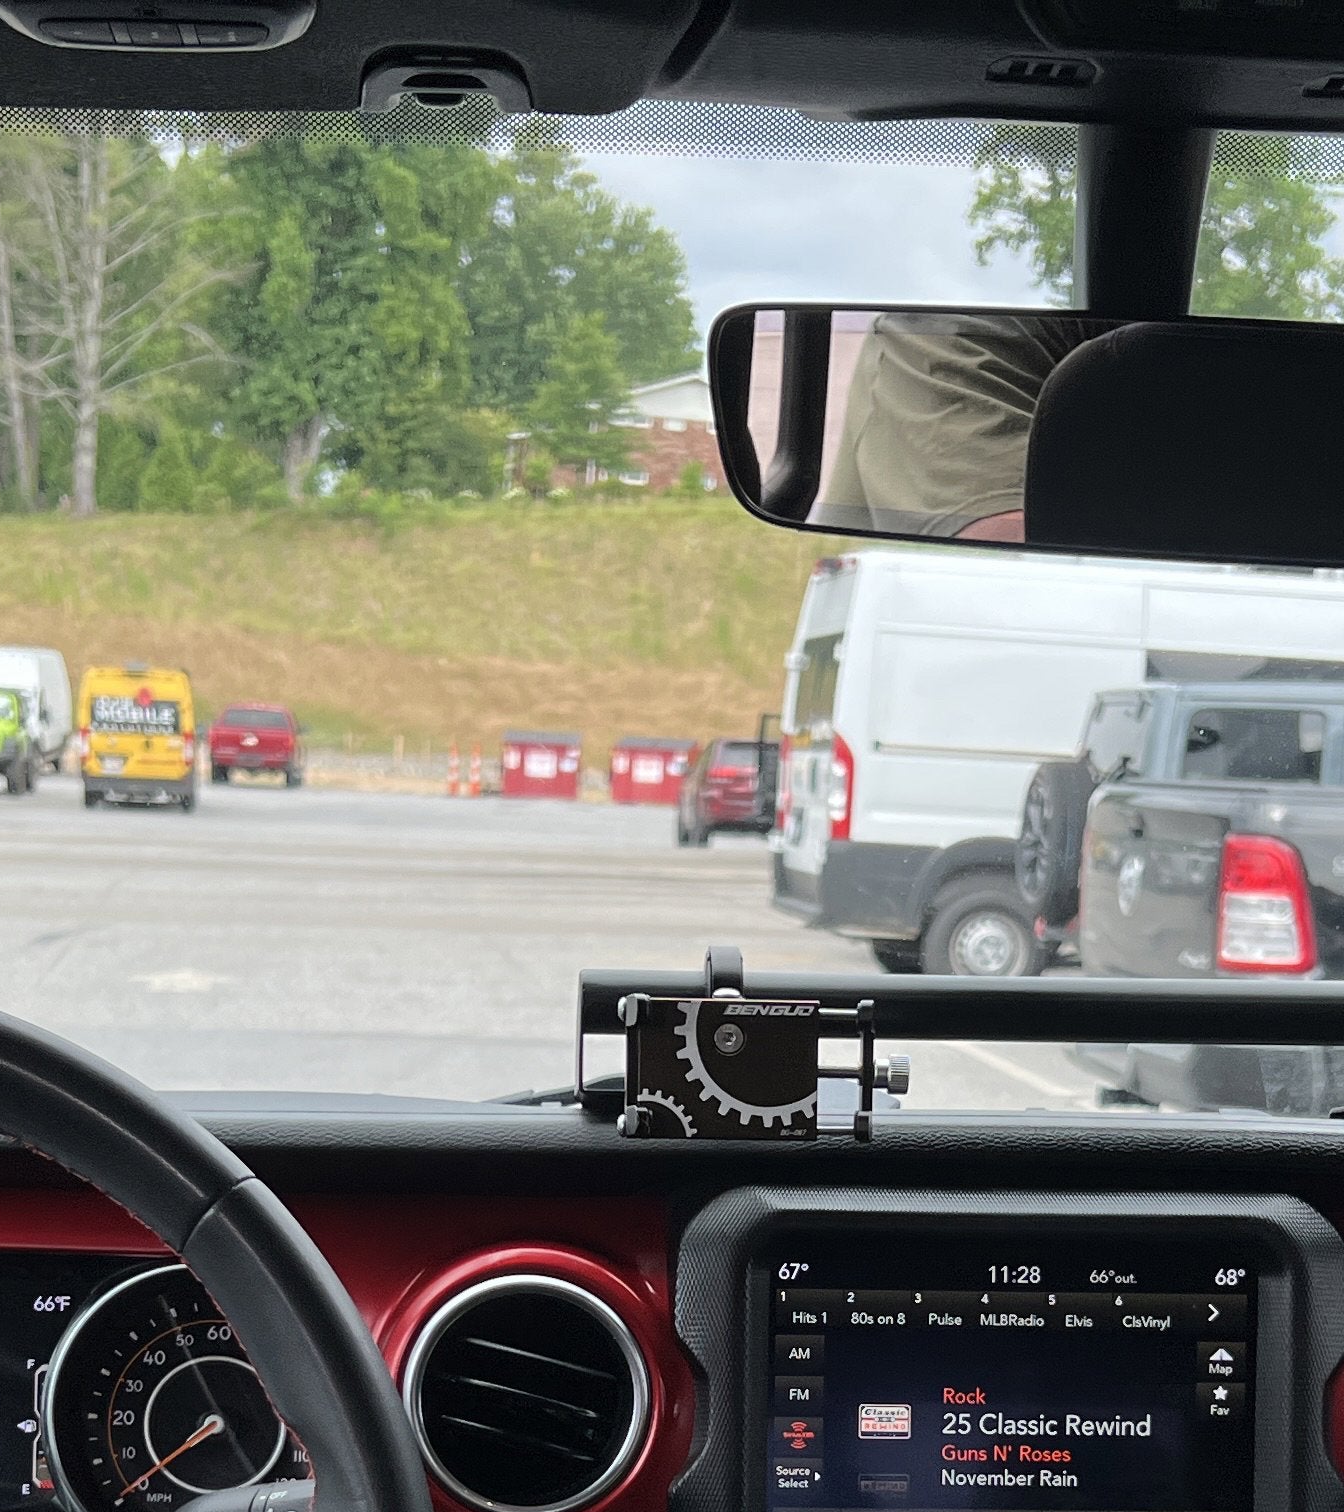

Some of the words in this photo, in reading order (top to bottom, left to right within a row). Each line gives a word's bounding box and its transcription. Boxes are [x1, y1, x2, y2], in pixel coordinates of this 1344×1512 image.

[723, 1004, 815, 1017] BENGUO
[988, 1265, 1041, 1285] 11:28
[780, 1291, 786, 1301] 1
[847, 1291, 855, 1302] 2
[914, 1293, 922, 1303] 3
[981, 1294, 989, 1304] 4
[1048, 1294, 1055, 1305] 5
[1115, 1295, 1123, 1306] 6
[792, 1311, 817, 1324] Hits
[822, 1312, 827, 1324] 1
[851, 1312, 874, 1325] 80s
[877, 1315, 894, 1324] on
[897, 1312, 906, 1324] 8
[928, 1312, 963, 1326] Pulse
[980, 1313, 1045, 1327] MLBRadio
[1065, 1315, 1093, 1327] Elvis
[1122, 1316, 1171, 1331] ClsVinyl
[207, 1326, 232, 1341] 60
[176, 1334, 195, 1346] 50
[143, 1350, 165, 1365] 40
[788, 1348, 810, 1359] AM
[27, 1359, 35, 1370] F
[1208, 1364, 1233, 1376] Map
[125, 1380, 144, 1392] 30
[789, 1388, 810, 1400] FM
[942, 1386, 986, 1405] Rock
[864, 1408, 906, 1417] Classic
[1210, 1405, 1230, 1415] Fav
[113, 1411, 135, 1425] 20
[941, 1412, 972, 1435] 25
[978, 1412, 1058, 1436] Classic
[1065, 1414, 1151, 1436] Rewind
[864, 1422, 906, 1430] REWIND
[122, 1446, 136, 1459] 10
[941, 1444, 988, 1461] Guns
[993, 1445, 1012, 1462] N'
[1019, 1445, 1072, 1462] Roses
[775, 1466, 811, 1477] Source
[941, 1468, 1034, 1486] November
[1039, 1470, 1078, 1487] Rain
[778, 1477, 808, 1488] Select
[22, 1484, 30, 1495] E
[146, 1493, 172, 1502] MPH
